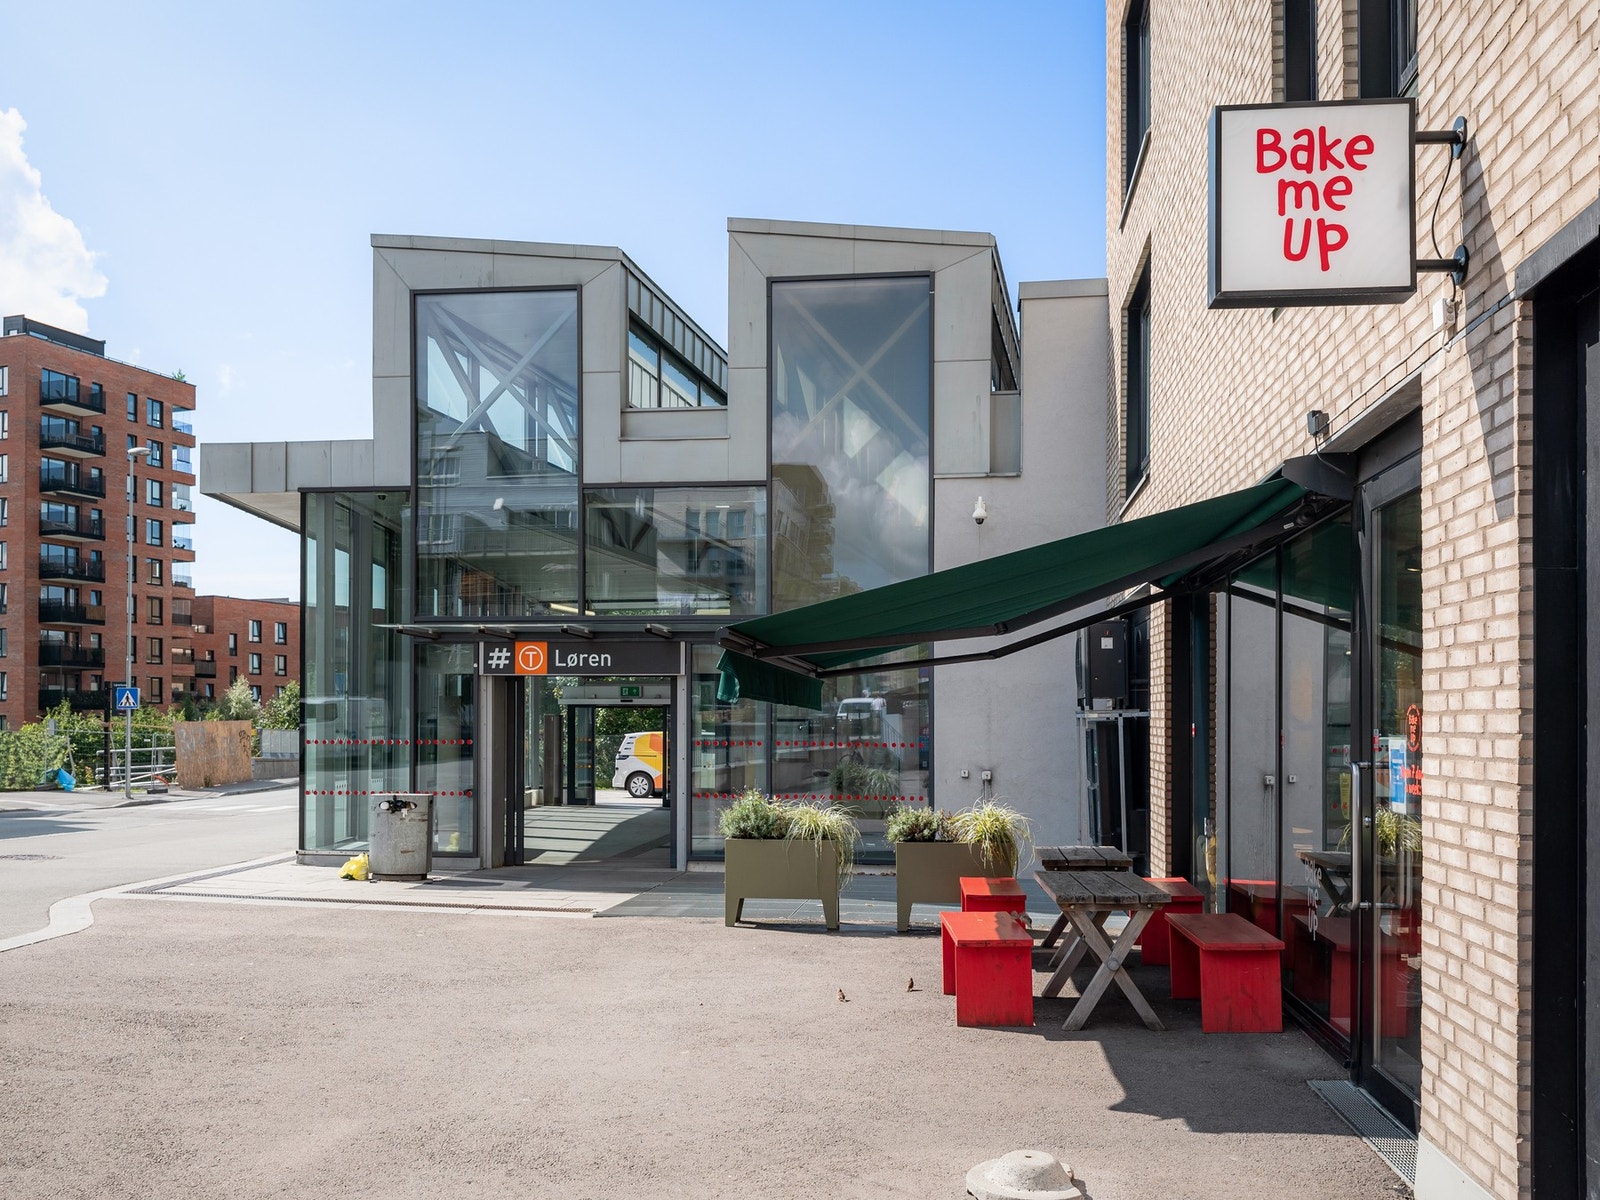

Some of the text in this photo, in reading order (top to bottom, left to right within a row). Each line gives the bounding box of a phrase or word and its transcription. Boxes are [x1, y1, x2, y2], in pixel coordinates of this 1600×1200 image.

[1256, 126, 1375, 174] Bake
[1278, 175, 1352, 216] me
[555, 649, 612, 667] Løren
